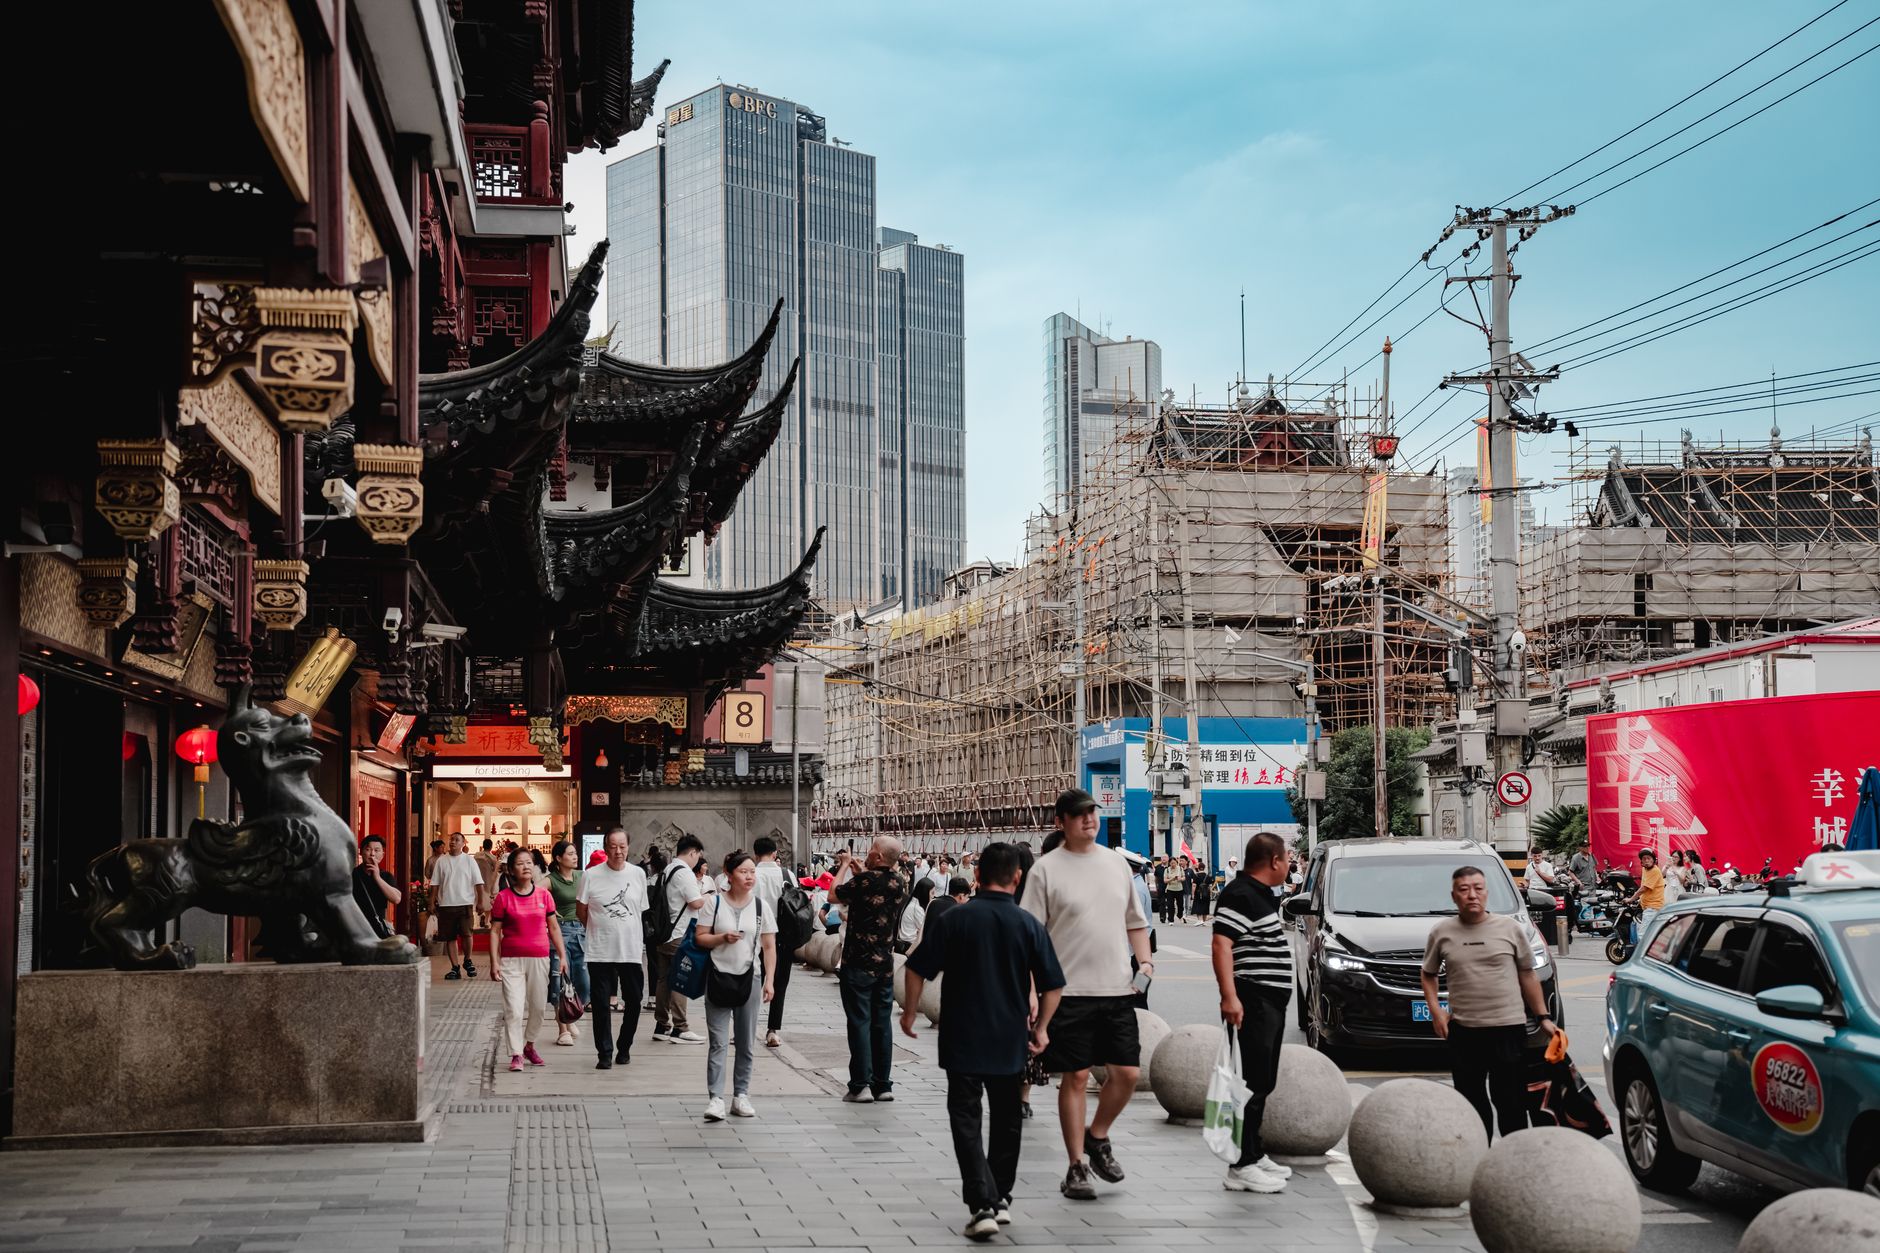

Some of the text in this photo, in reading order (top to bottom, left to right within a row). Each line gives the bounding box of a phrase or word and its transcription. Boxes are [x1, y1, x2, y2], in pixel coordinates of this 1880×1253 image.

[735, 701, 754, 728] 8
[478, 731, 528, 752] 祈豫
[1142, 749, 1257, 763] 防精细到位
[474, 765, 531, 777] for blessing
[1100, 776, 1121, 790] 高
[1101, 793, 1122, 806] 平
[1821, 862, 1856, 880] 大
[1766, 1058, 1806, 1087] 96822
